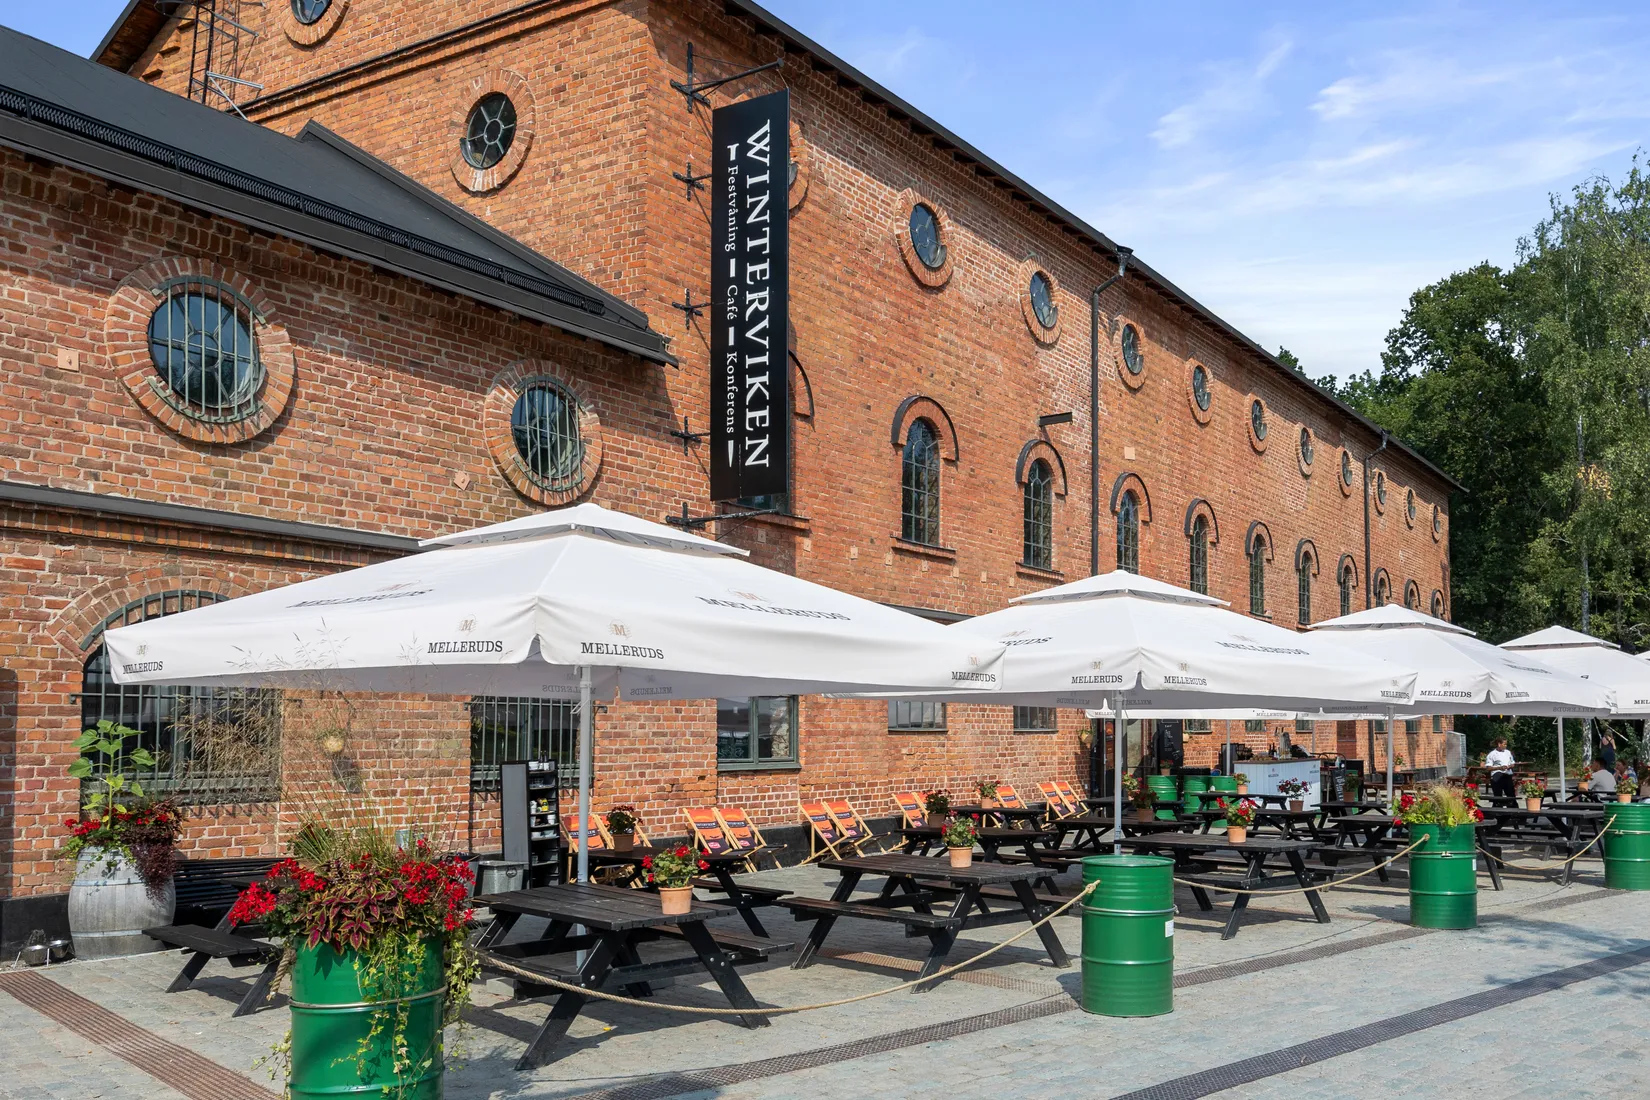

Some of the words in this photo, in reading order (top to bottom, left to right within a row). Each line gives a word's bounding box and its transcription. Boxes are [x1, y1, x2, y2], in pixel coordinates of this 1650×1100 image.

[724, 164, 739, 252] Festvåning
[744, 119, 771, 469] WINTERVIKEN
[726, 284, 739, 321] Café
[726, 352, 739, 434] Konferens
[427, 640, 503, 654] MELLERUDS
[580, 641, 665, 660] MELLERUDS
[122, 660, 164, 675] MELLERUDS
[951, 670, 996, 683] MELLERUDS
[1071, 674, 1123, 684] MELLERUDS
[1163, 675, 1208, 686] MELLERUDS
[1420, 690, 1472, 698] MELLERUDS
